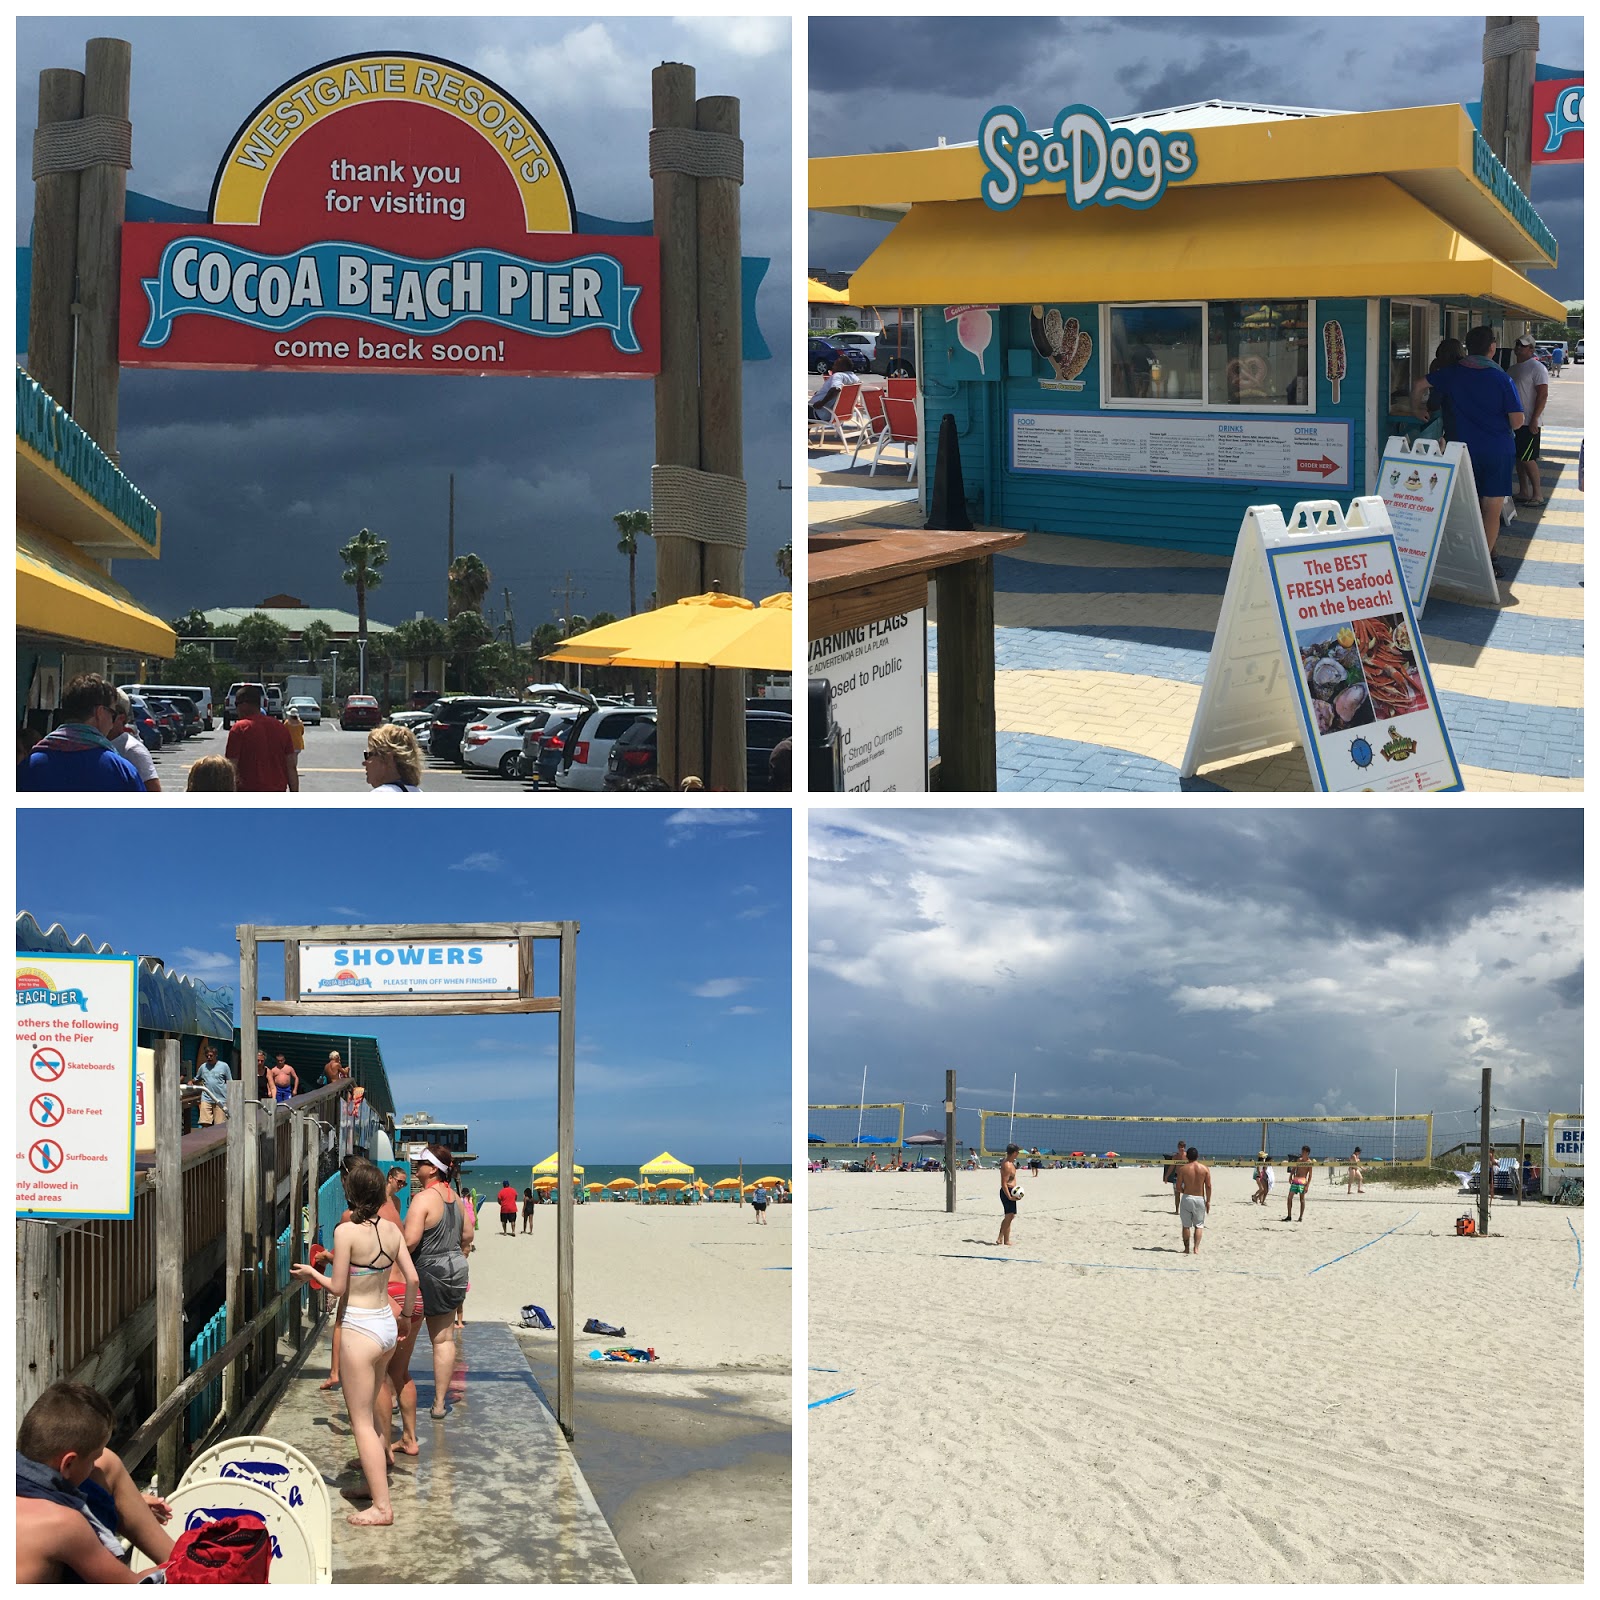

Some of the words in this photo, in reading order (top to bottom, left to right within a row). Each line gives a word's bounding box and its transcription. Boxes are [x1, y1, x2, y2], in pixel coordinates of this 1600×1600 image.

[237, 64, 405, 171] WESTGATE
[414, 67, 549, 184] RESORTS
[330, 159, 405, 182] thank
[412, 165, 461, 188] you
[325, 190, 363, 212] for
[370, 192, 465, 220] visiting
[171, 247, 323, 318] COCOA
[338, 255, 483, 322] BEACH
[499, 265, 603, 325] PIER
[274, 341, 349, 359] come
[358, 338, 424, 361] back
[431, 341, 505, 362] soon!
[1294, 427, 1318, 435] OTHER
[1417, 504, 1435, 512] CREAM
[1303, 560, 1332, 576] The
[1334, 553, 1367, 572] BEST
[1286, 578, 1335, 599] FRESH
[1337, 569, 1394, 592] Seafood
[1299, 605, 1318, 619] on
[1320, 598, 1345, 616] the
[1346, 590, 1393, 612] beach!
[869, 613, 908, 639] FLAGS
[814, 650, 855, 673] ADVERTENCIA
[855, 647, 864, 657] EN
[864, 643, 873, 654] LA
[873, 637, 889, 651] PLAYA
[859, 671, 869, 686] to
[873, 657, 902, 681] Public
[849, 741, 872, 761] Strong
[874, 725, 903, 748] Currents
[334, 947, 484, 966] SHOWERS
[49, 991, 77, 1005] PIER
[17, 1018, 51, 1028] others
[52, 1019, 70, 1028] the
[71, 1019, 119, 1032] following
[55, 1033, 72, 1042] the
[74, 1033, 94, 1042] Pier
[67, 1062, 115, 1070] Skateboards
[67, 1107, 84, 1115] Bare
[86, 1107, 103, 1115] Feet
[66, 1153, 108, 1161] Surfboards
[1556, 1142, 1584, 1153] REN
[32, 1181, 68, 1190] allowed
[70, 1182, 79, 1190] in
